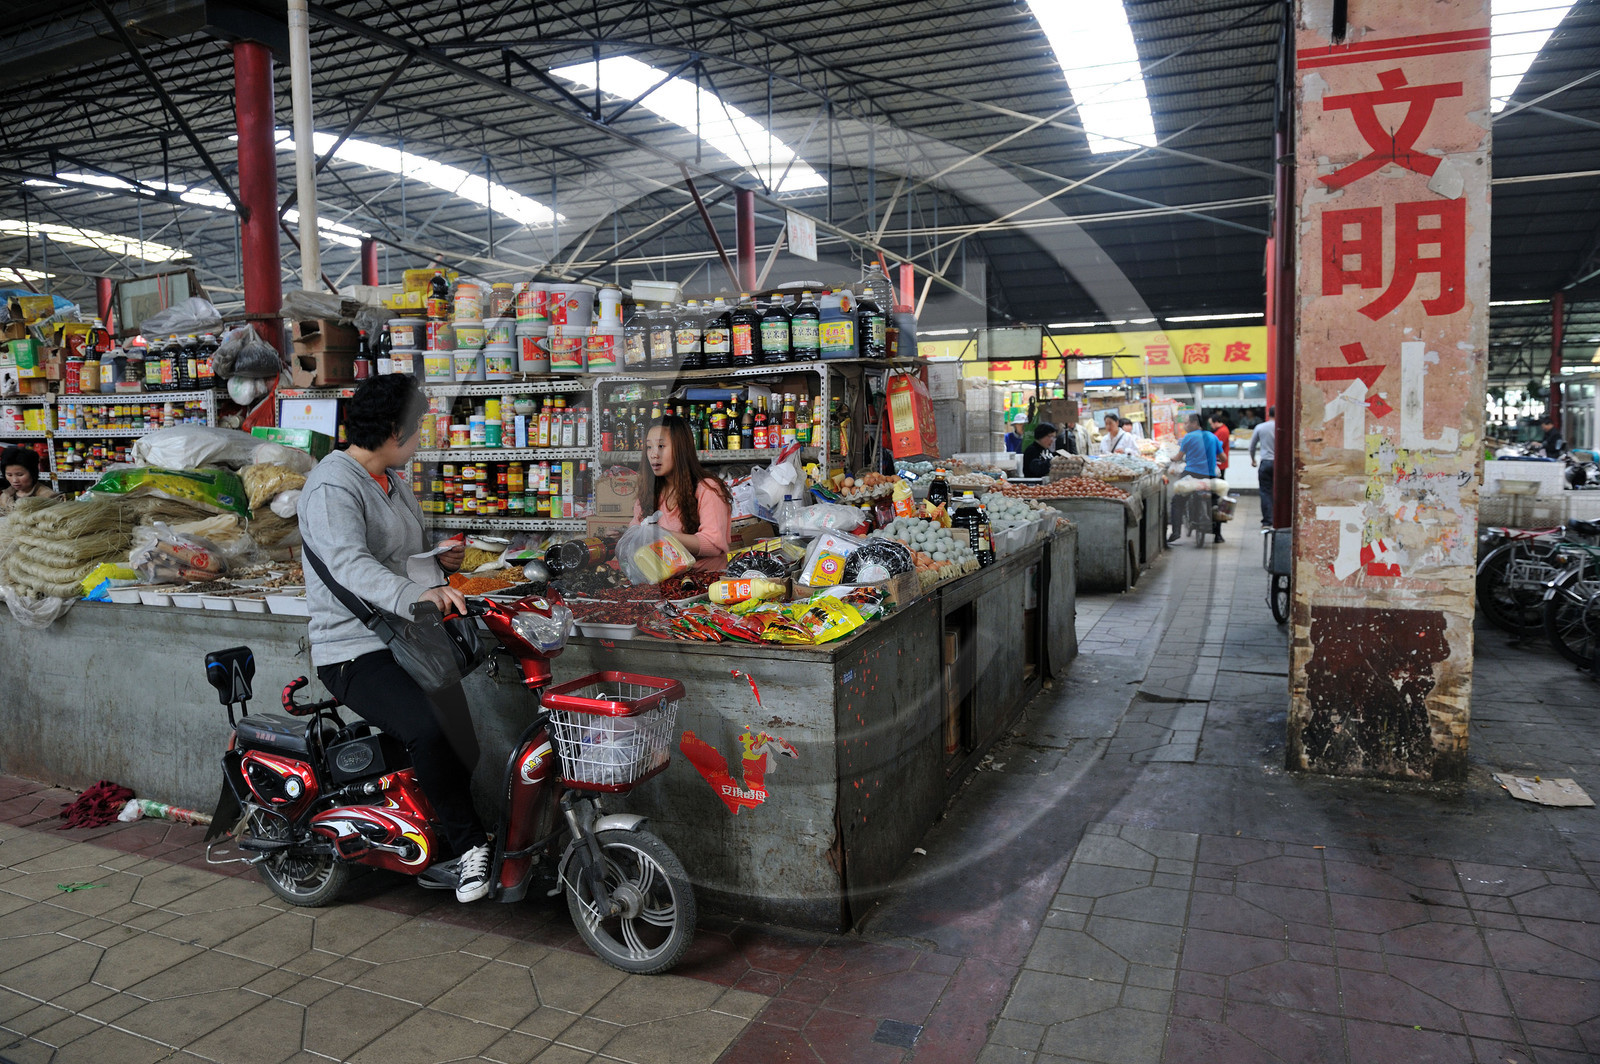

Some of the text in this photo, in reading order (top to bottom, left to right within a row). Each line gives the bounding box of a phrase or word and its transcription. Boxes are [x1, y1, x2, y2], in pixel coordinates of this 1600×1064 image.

[1144, 340, 1251, 366] 豆腐皮
[523, 755, 543, 774] AAA
